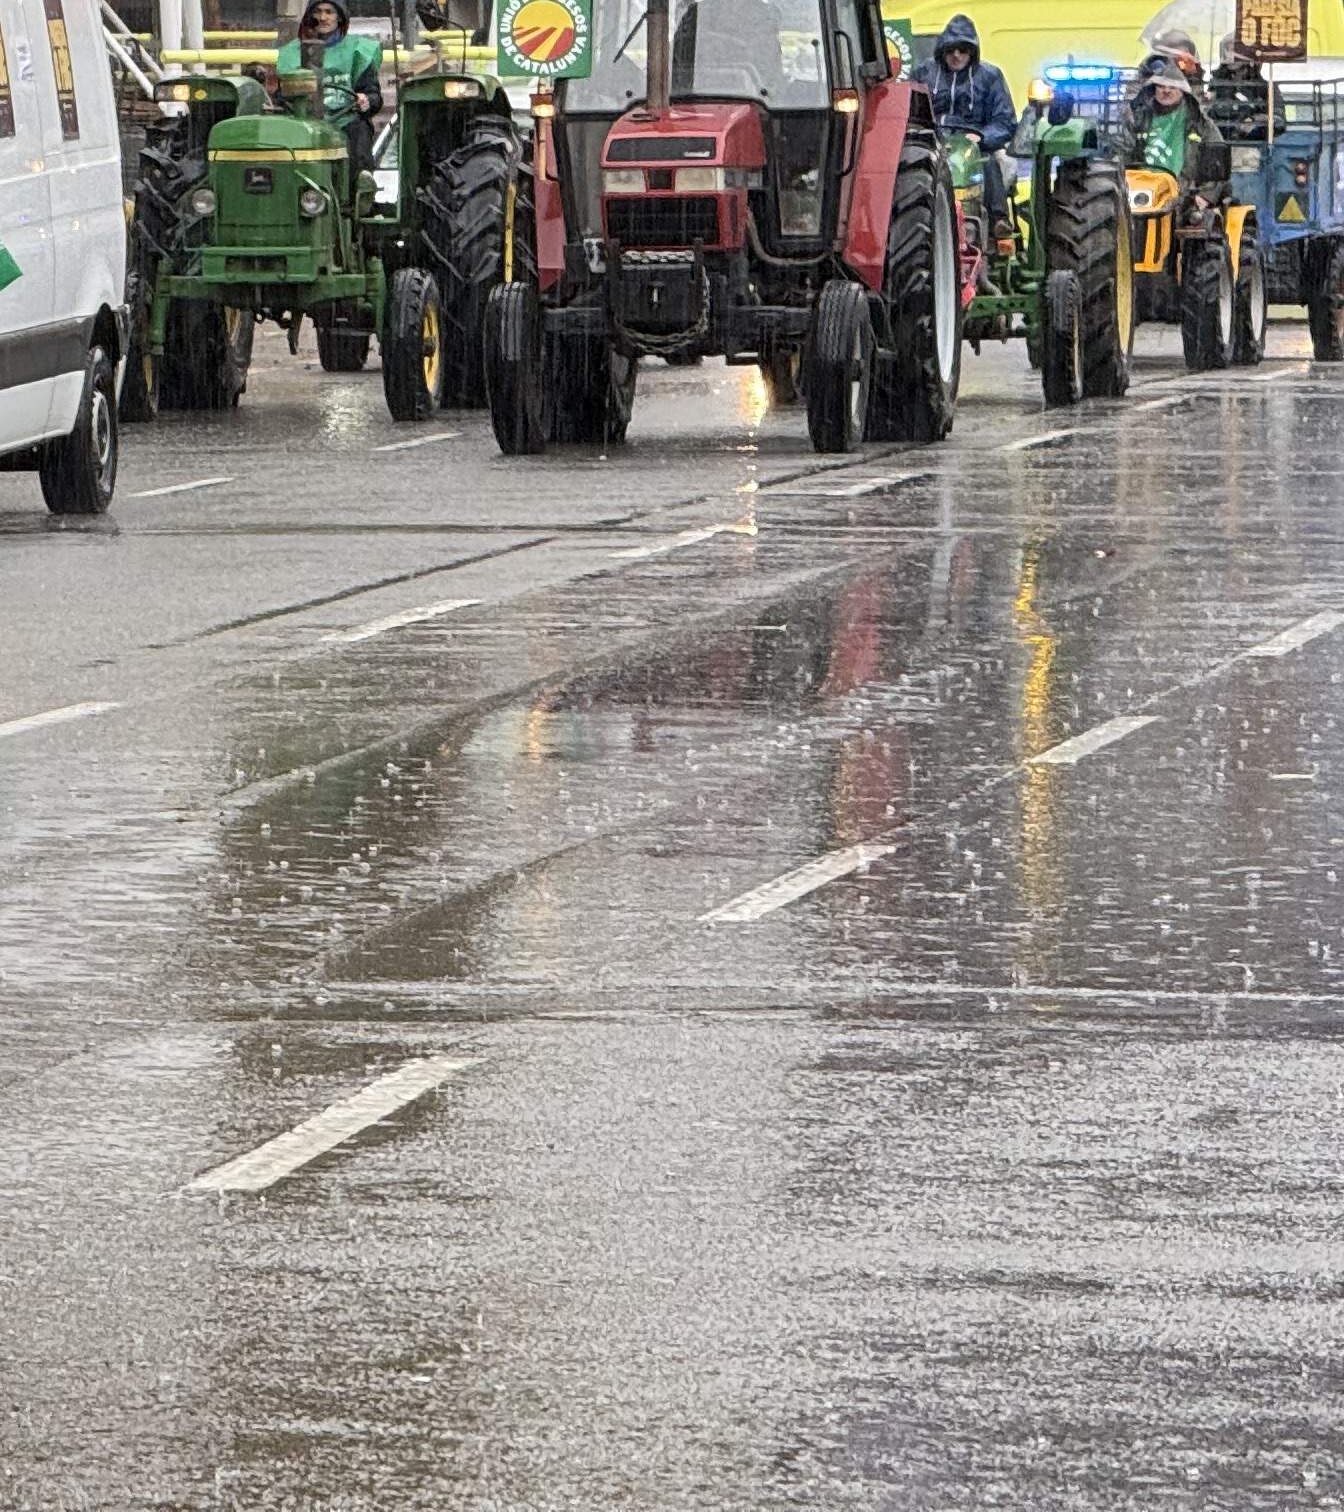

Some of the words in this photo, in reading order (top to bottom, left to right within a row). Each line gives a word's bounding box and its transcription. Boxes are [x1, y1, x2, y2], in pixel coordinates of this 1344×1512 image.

[500, 0, 521, 33] UNIÓ
[501, 36, 517, 57] DE
[513, 36, 587, 74] CATALUNYA
